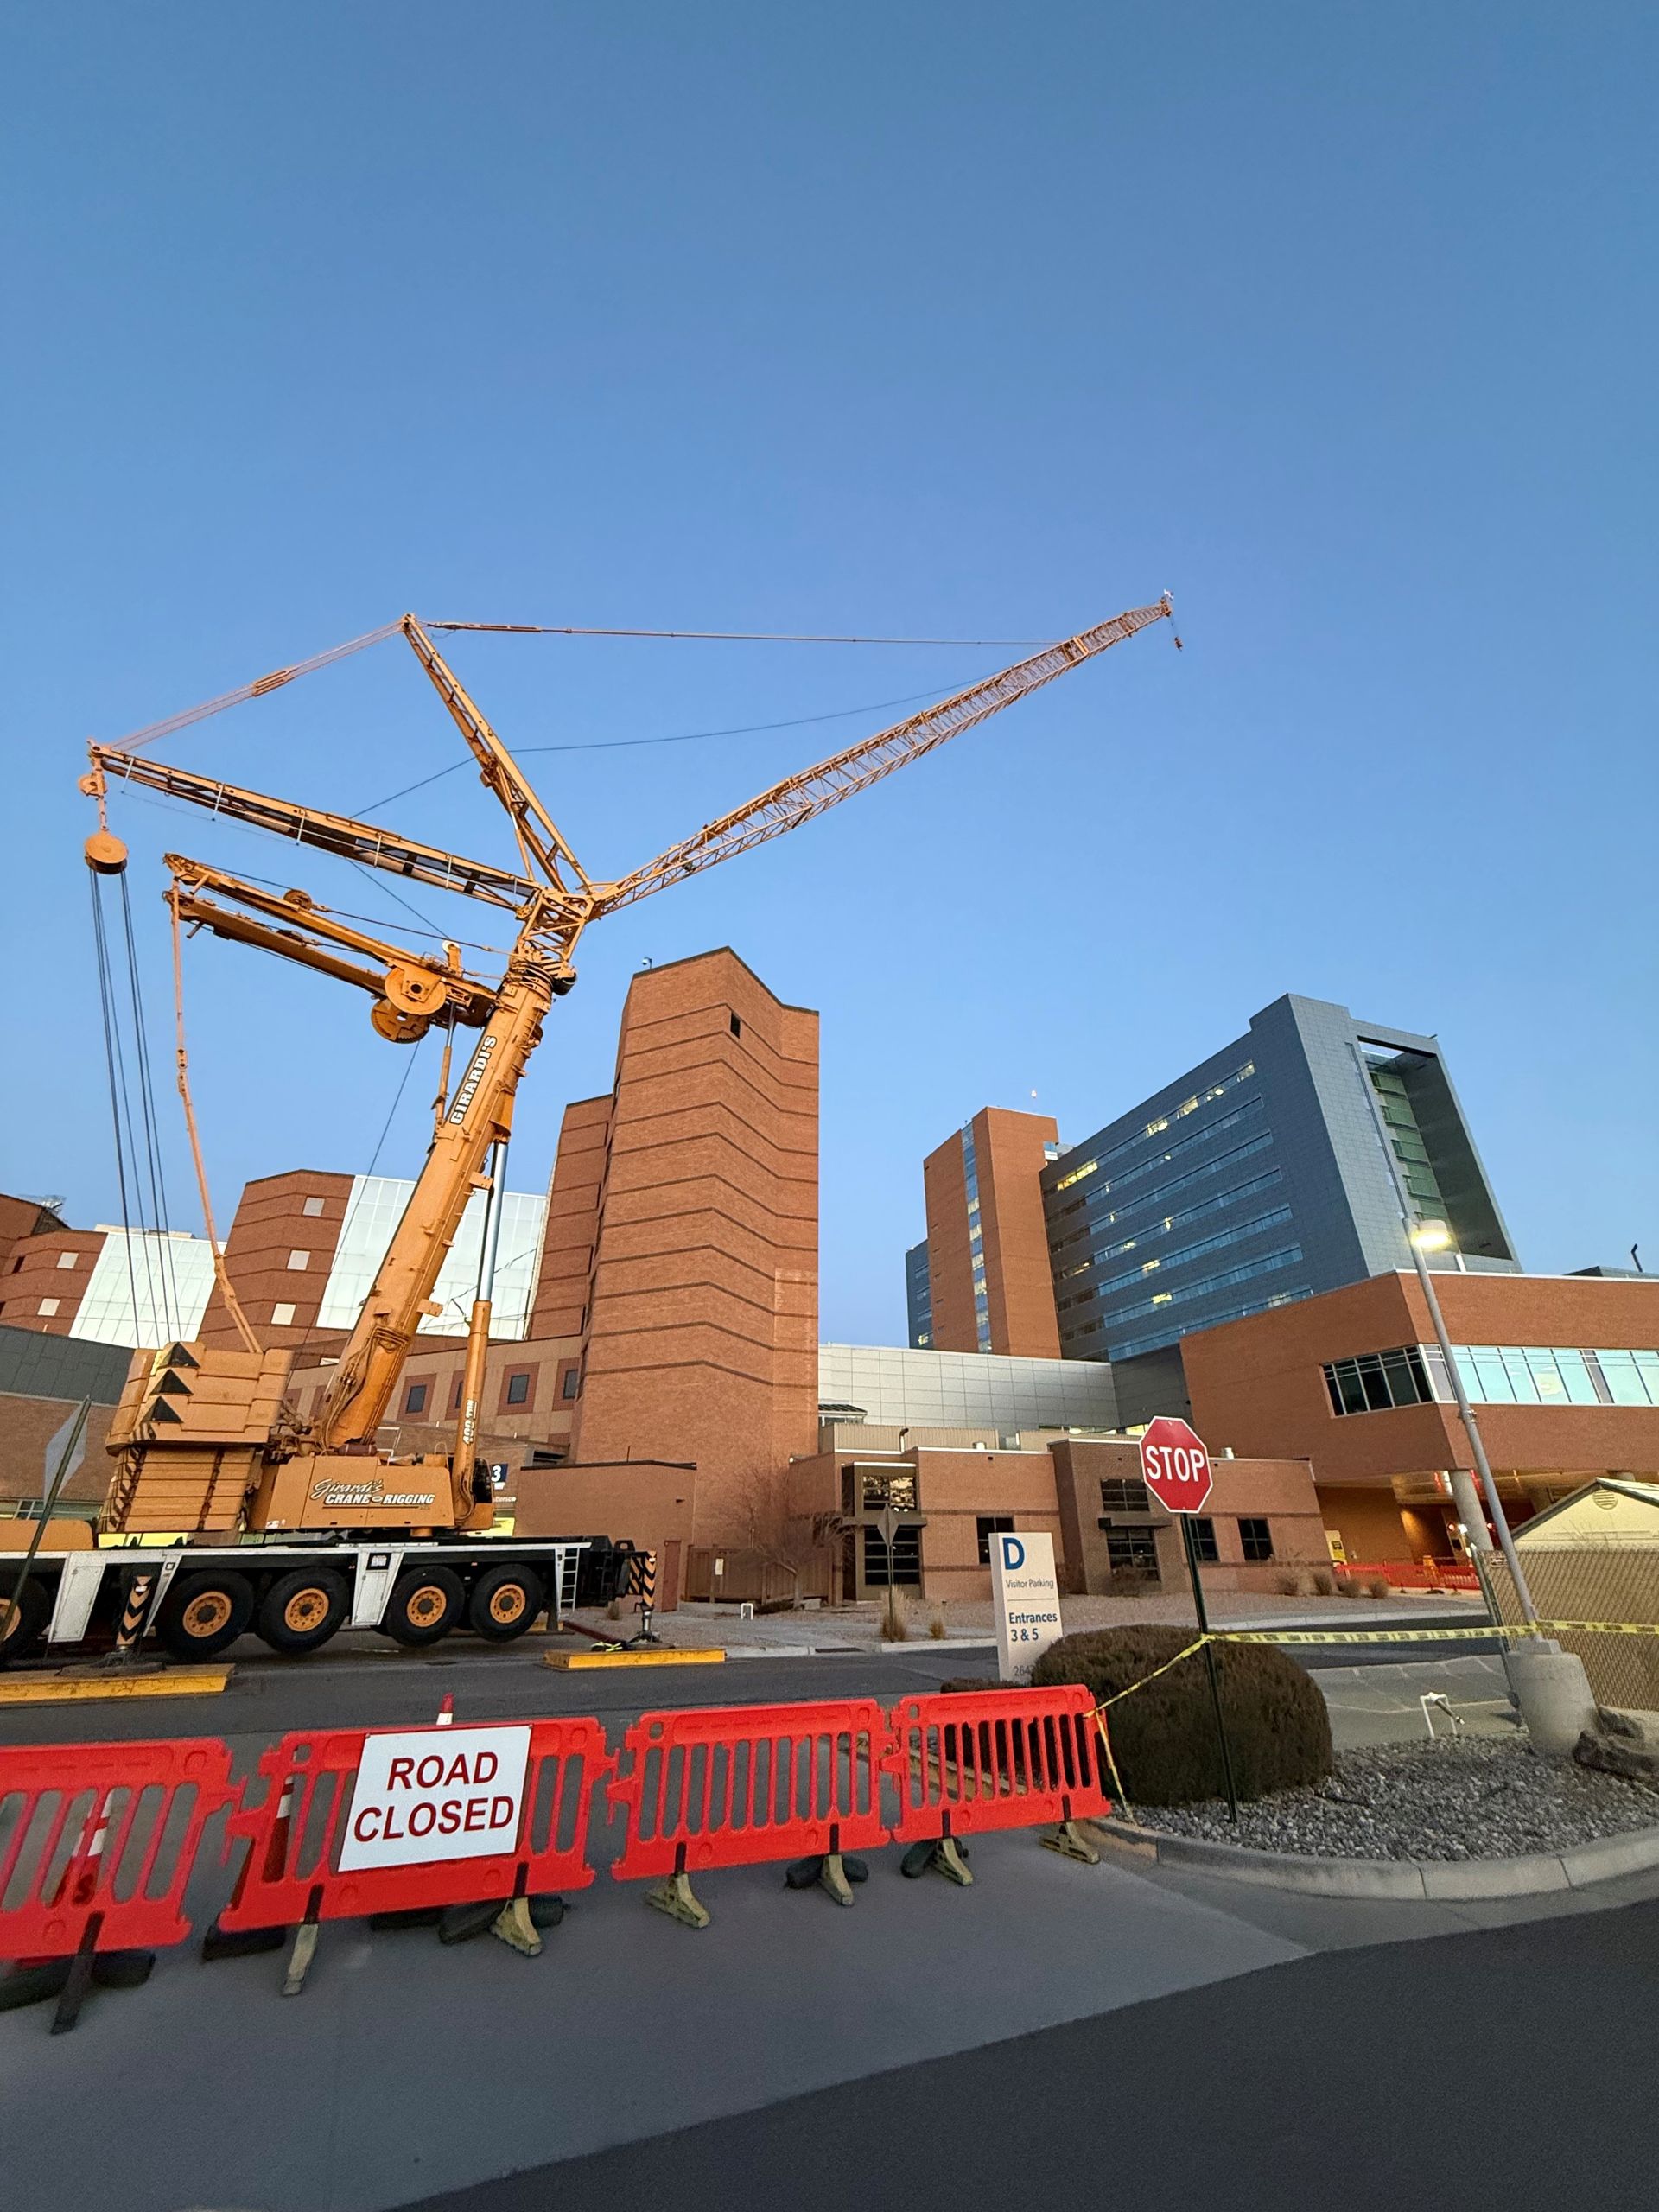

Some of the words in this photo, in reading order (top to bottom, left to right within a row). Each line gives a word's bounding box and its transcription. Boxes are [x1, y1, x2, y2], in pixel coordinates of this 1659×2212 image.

[450, 1036, 497, 1125] GIRARDI'S
[491, 1465, 502, 1482] 3
[1146, 1445, 1205, 1483] STOP
[310, 1478, 383, 1499] Girardi's
[324, 1494, 372, 1504] CRANE
[381, 1494, 435, 1504] RIGGING
[1002, 1537, 1025, 1570] D
[1006, 1579, 1027, 1589] Visitor
[1028, 1578, 1054, 1589] Parking
[1008, 1612, 1058, 1624] Entrances
[1011, 1629, 1018, 1642] 3
[1020, 1629, 1029, 1641] &
[1032, 1628, 1039, 1641] 5
[386, 1751, 499, 1791] ROAD
[353, 1796, 515, 1843] CLOSED
